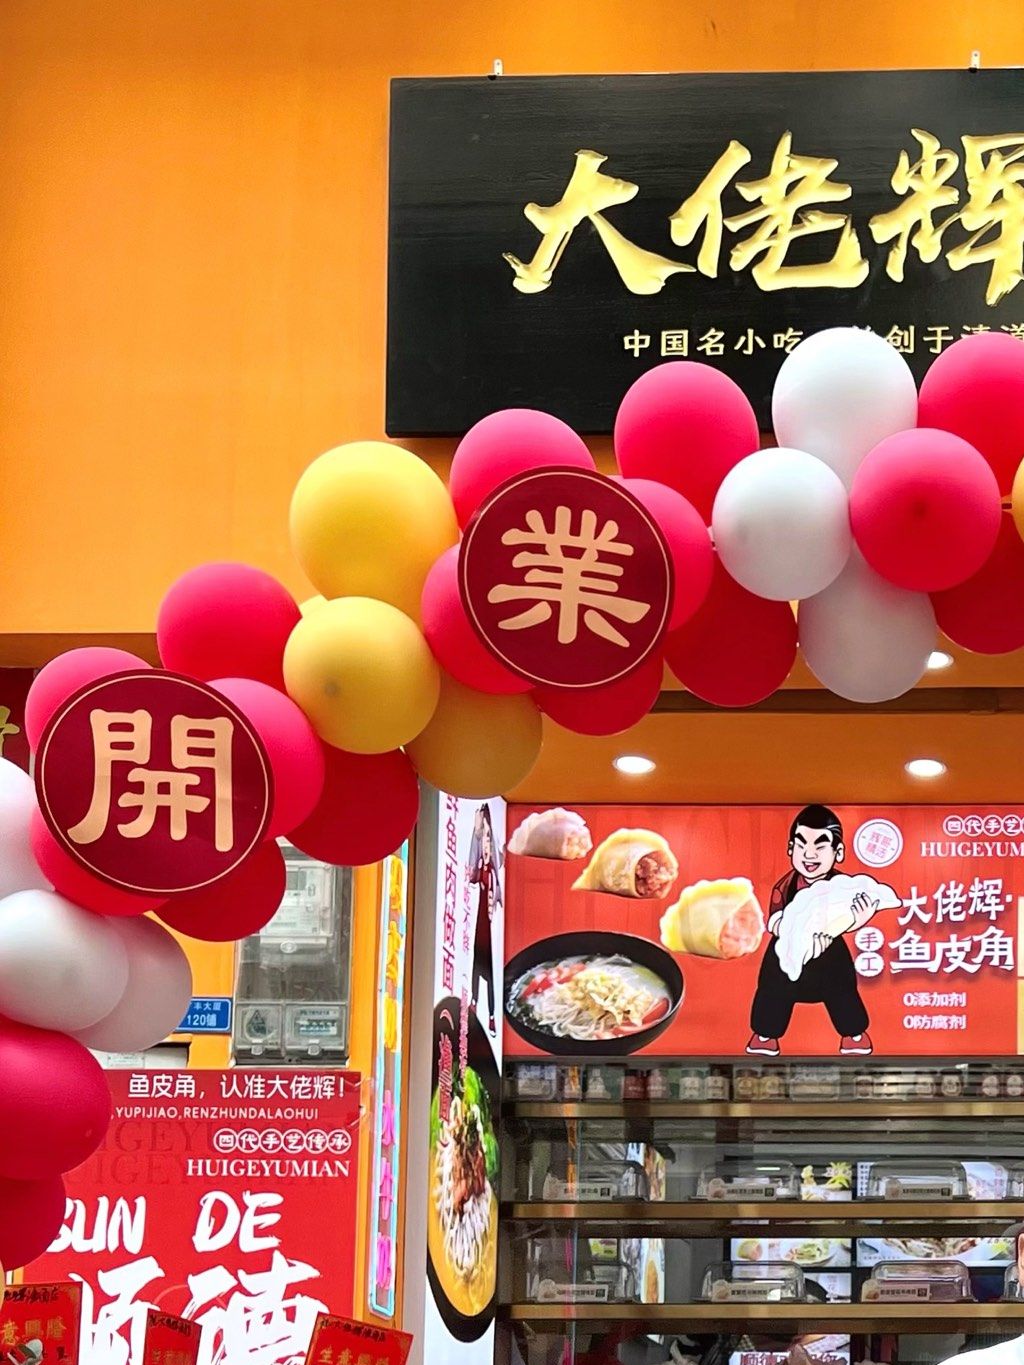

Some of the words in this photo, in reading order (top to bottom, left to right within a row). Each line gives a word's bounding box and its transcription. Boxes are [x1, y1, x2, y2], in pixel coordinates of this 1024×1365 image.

[488, 506, 651, 648] 業
[68, 709, 234, 852] 開
[858, 931, 881, 973] 手工
[888, 926, 1014, 973] 鱼皮角
[903, 992, 966, 1007] 0添加剂
[903, 1014, 966, 1030] 0防腐剂
[215, 1130, 351, 1152] 四代手艺传承
[186, 1158, 350, 1178] HUIGEYUMIAN
[191, 1190, 284, 1254] DE
